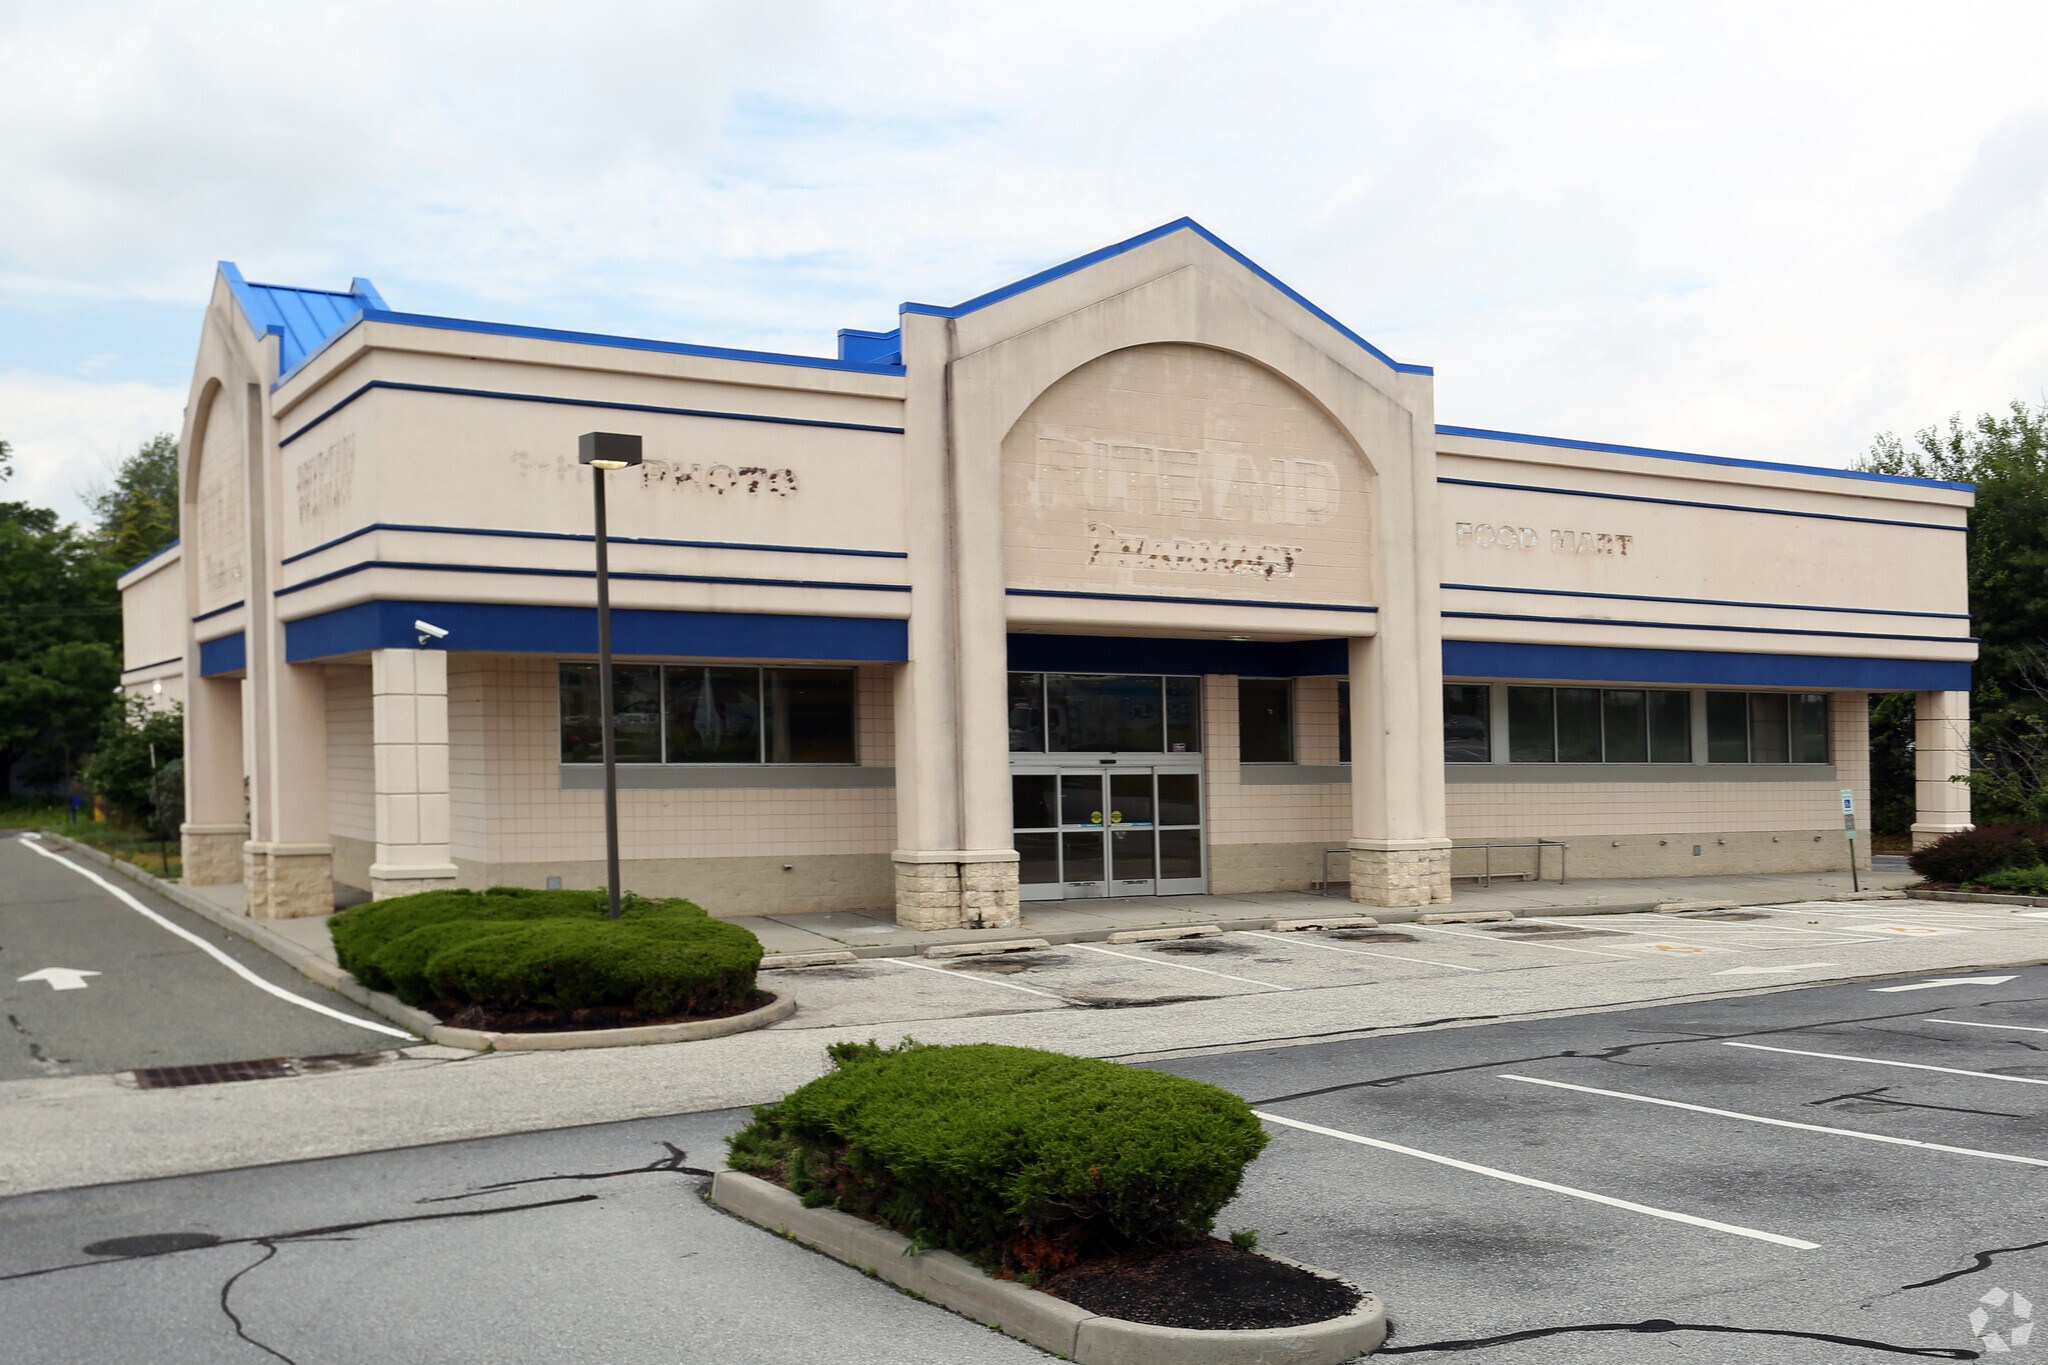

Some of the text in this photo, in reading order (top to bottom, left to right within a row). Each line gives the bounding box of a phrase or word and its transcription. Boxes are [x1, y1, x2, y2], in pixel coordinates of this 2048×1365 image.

[640, 459, 800, 498] PHOTO
[1455, 521, 1633, 556] FOOD MART
